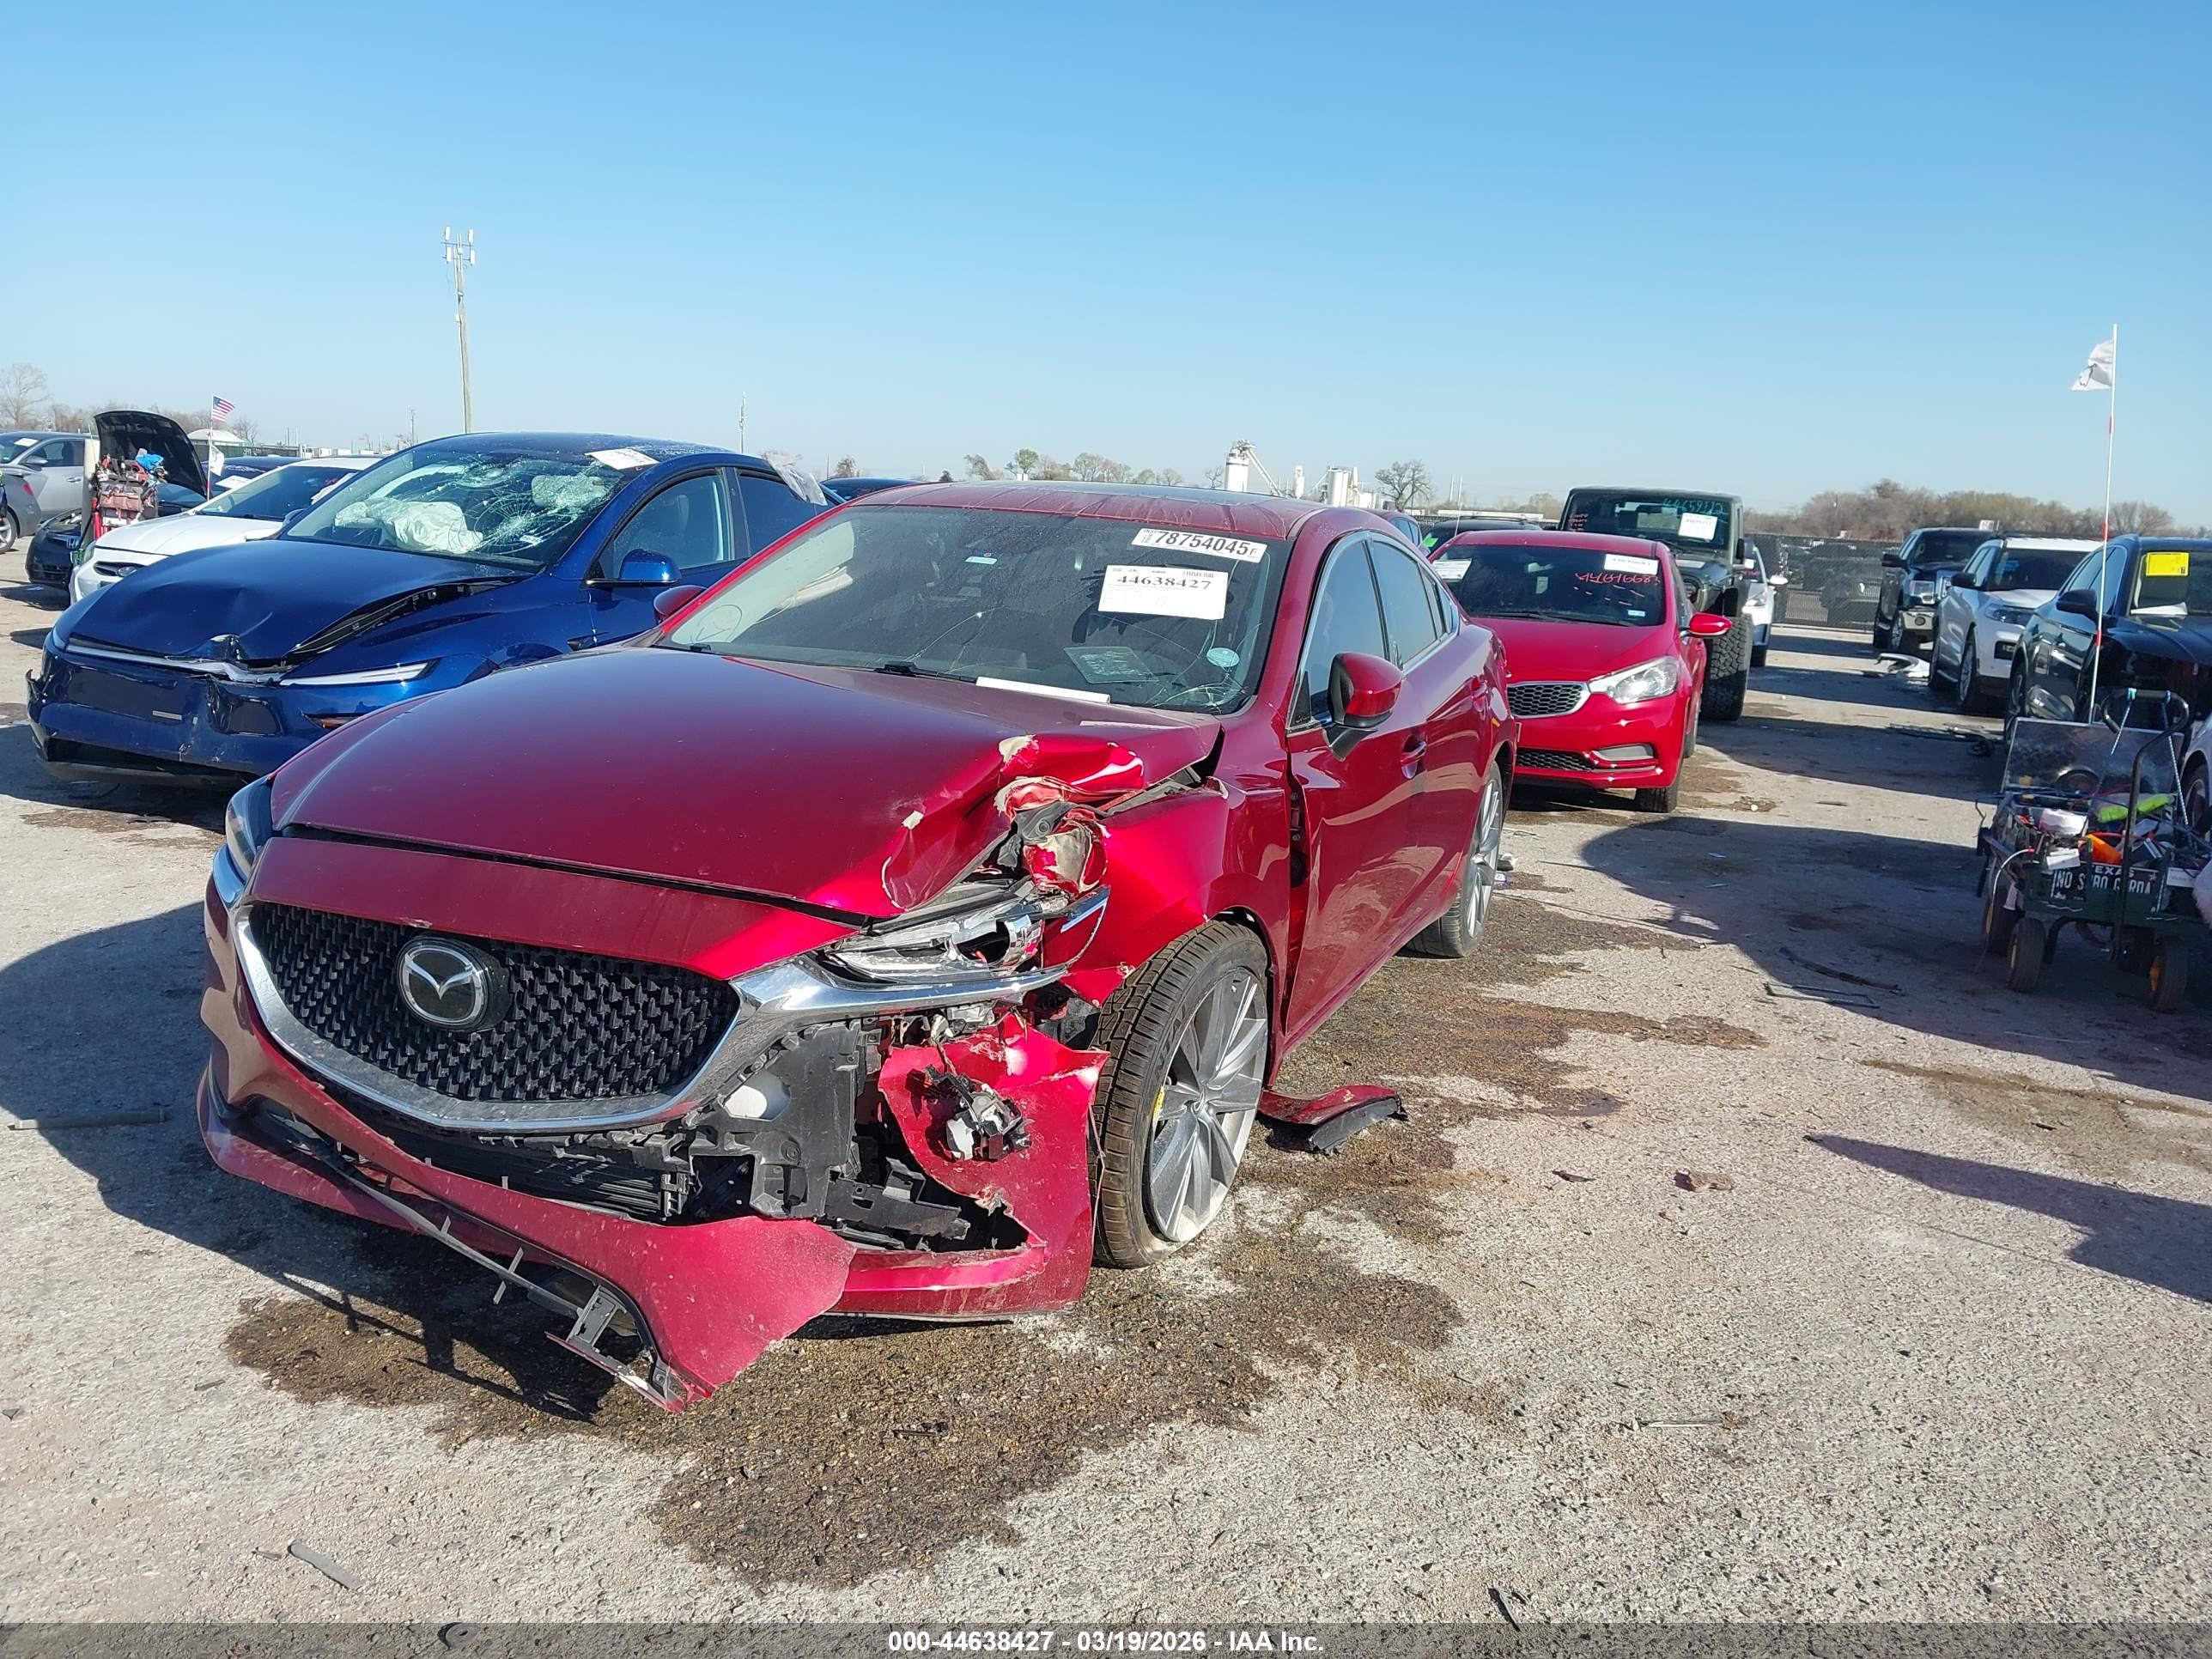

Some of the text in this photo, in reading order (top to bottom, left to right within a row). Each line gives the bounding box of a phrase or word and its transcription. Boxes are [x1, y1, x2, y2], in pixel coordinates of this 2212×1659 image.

[1155, 531, 1251, 556] 78754045
[1116, 576, 1212, 590] 44638427
[2091, 865, 2135, 878] EXAS
